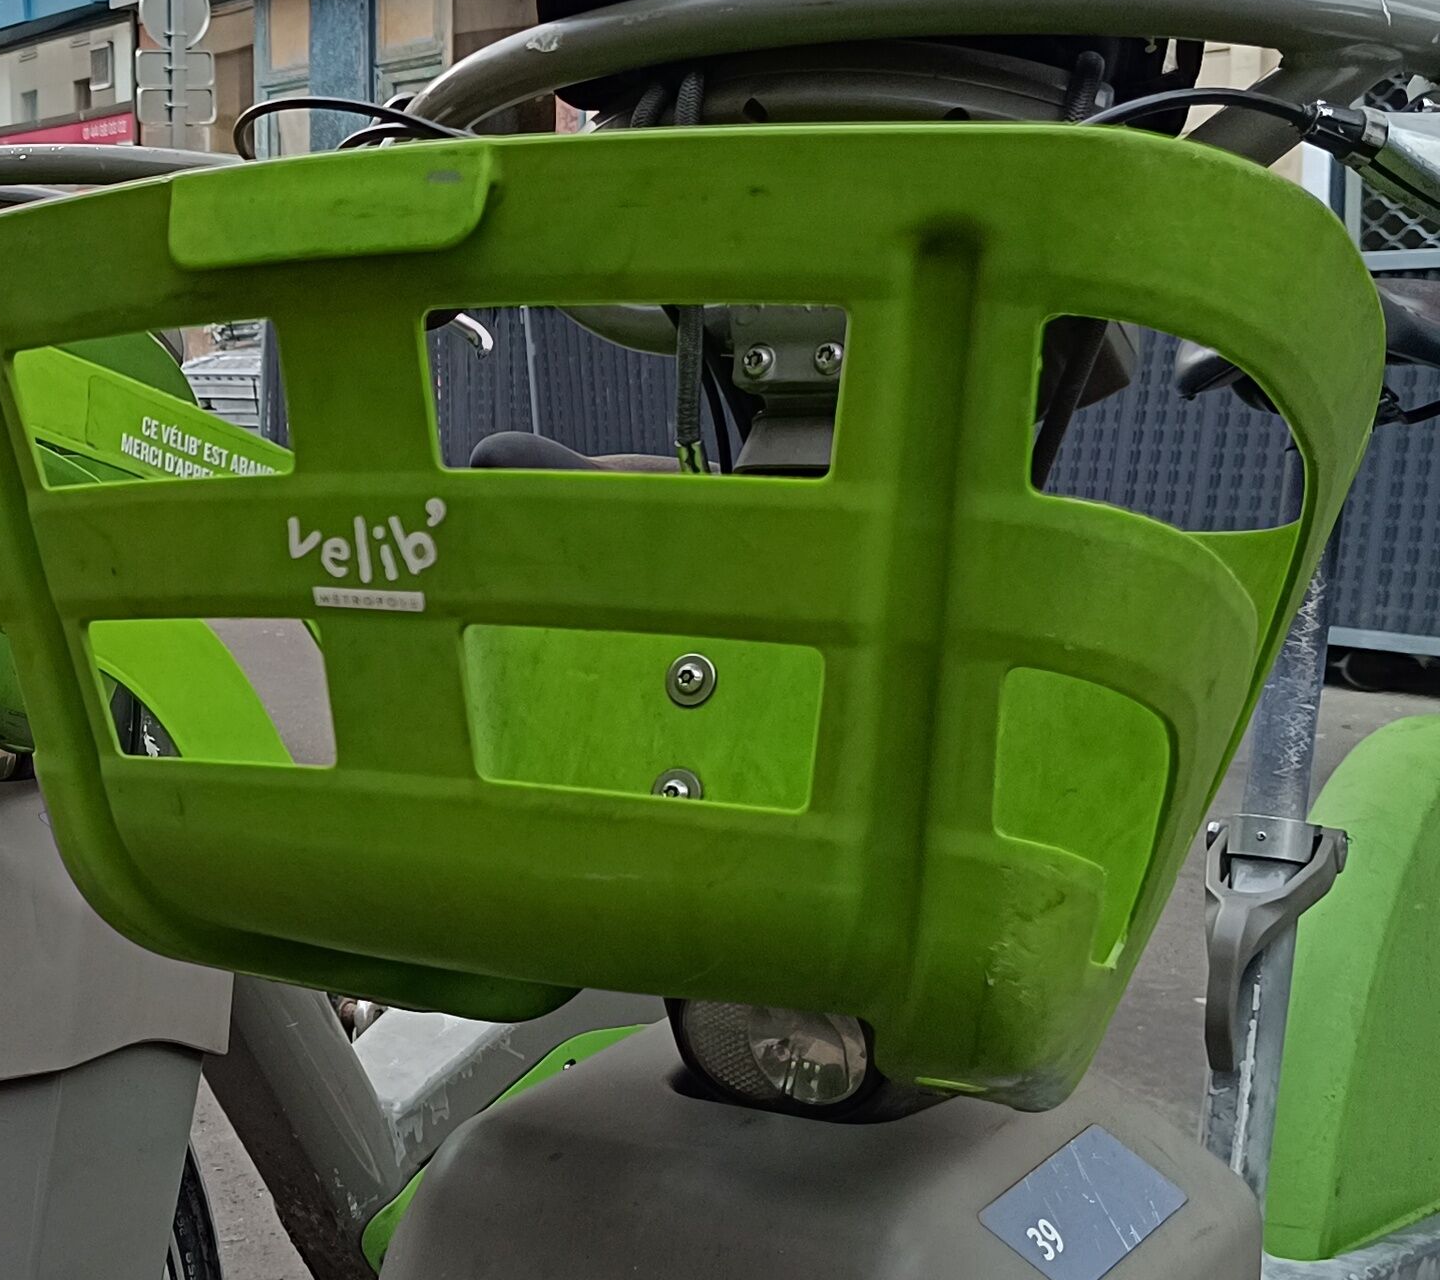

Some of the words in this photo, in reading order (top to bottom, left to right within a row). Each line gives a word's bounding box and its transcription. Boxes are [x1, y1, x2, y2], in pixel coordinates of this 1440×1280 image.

[120, 432, 161, 469] MERCI
[141, 416, 160, 440] CE
[161, 423, 201, 456] VÉLIB'
[203, 442, 229, 469] EST
[1026, 1218, 1064, 1261] 39
